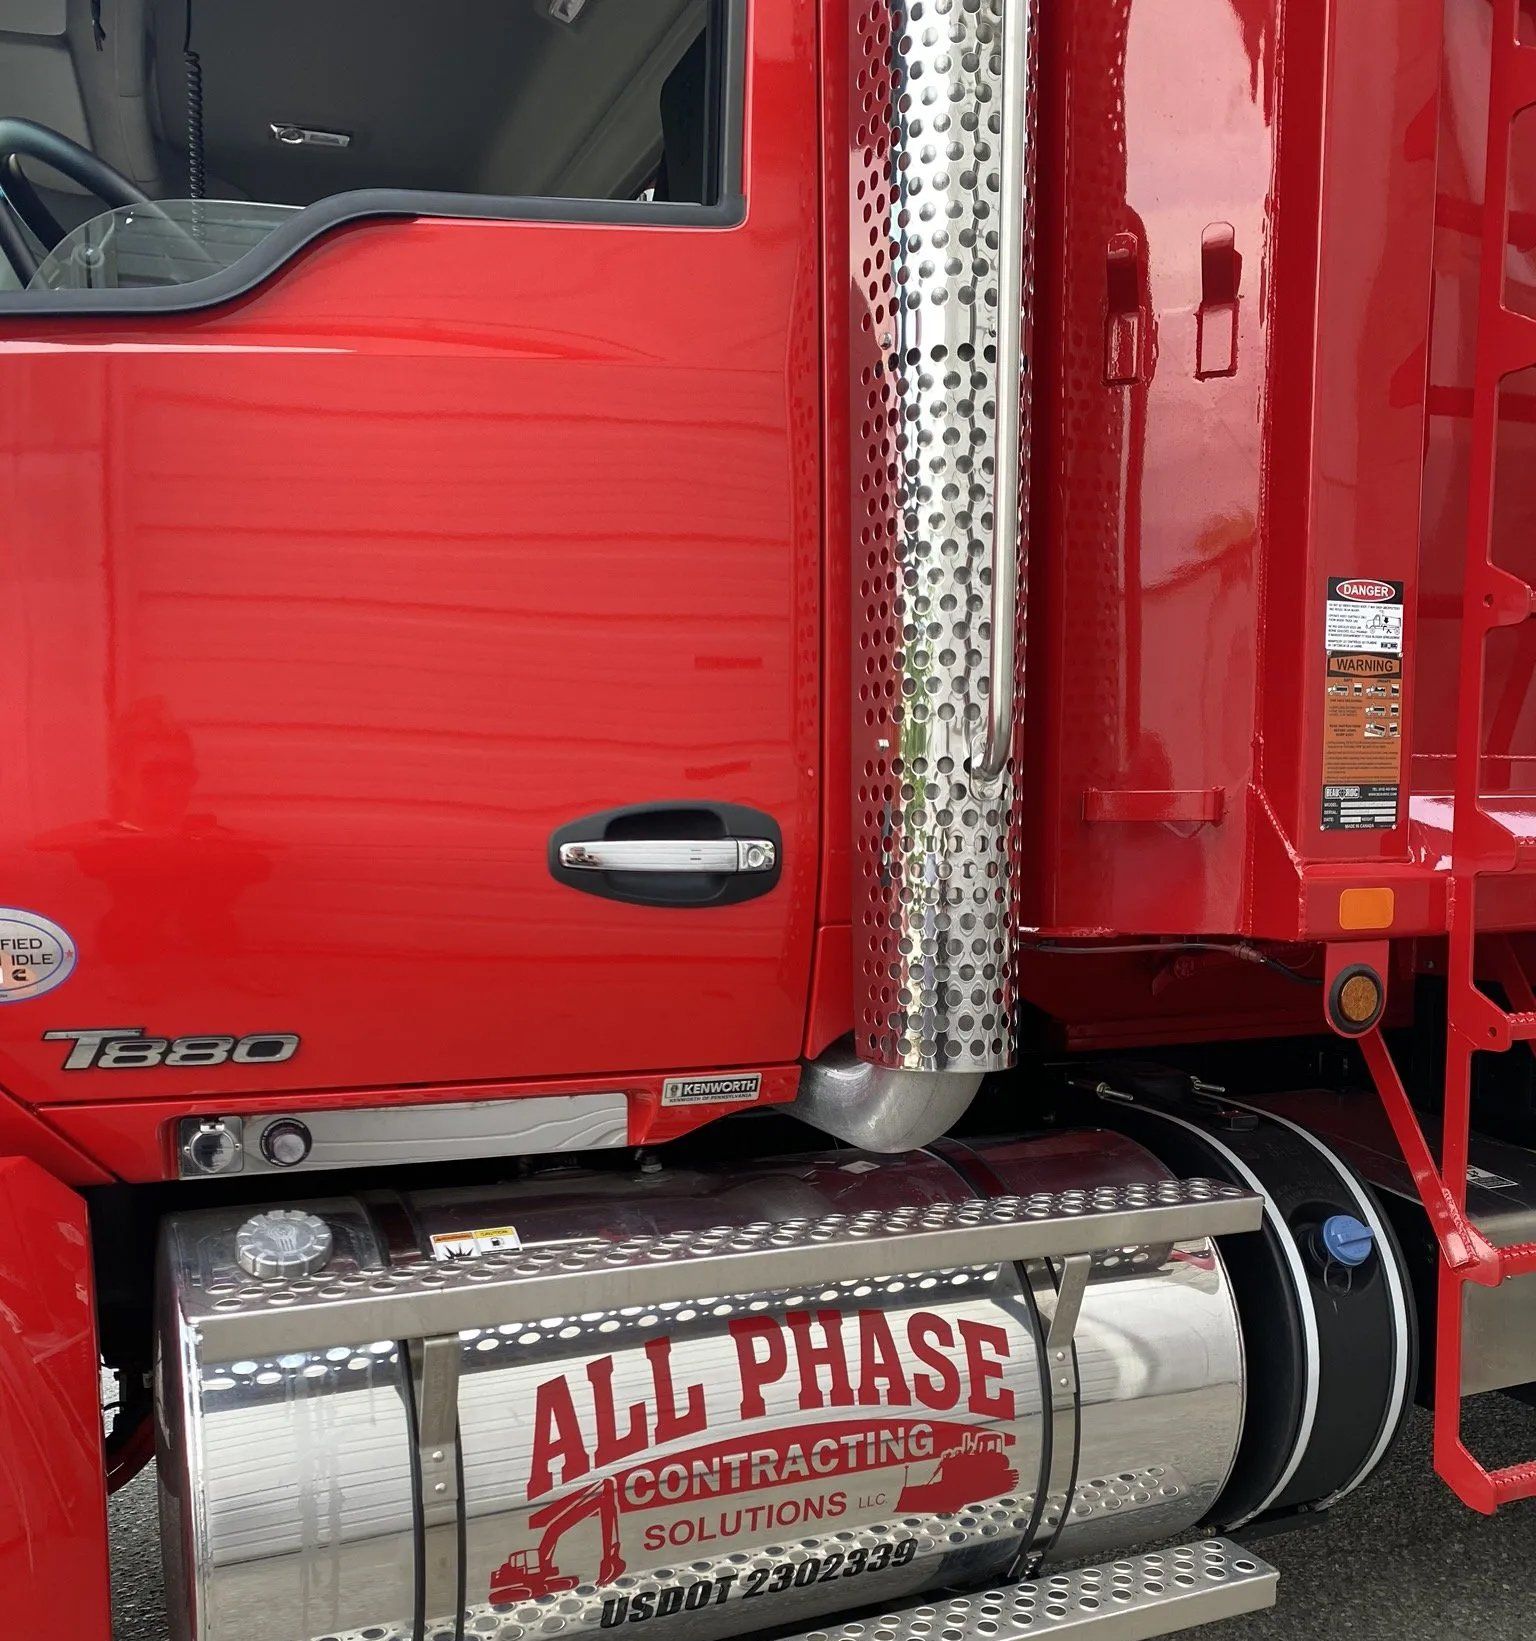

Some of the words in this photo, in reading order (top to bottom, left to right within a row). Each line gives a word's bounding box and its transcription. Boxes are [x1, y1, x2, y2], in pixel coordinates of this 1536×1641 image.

[1343, 584, 1389, 597] DANGER
[1337, 659, 1393, 672] WARNING
[11, 953, 54, 966] IDLE
[41, 1028, 301, 1070] T880
[684, 1080, 757, 1095] KENWORTH
[526, 1335, 708, 1502] ALL
[727, 1309, 1016, 1421] PHASE
[623, 1423, 935, 1506] CONTRACTING
[643, 1491, 848, 1551] SOLUTIONS
[600, 1574, 739, 1629] USDOT
[742, 1537, 919, 1600] 2302339
